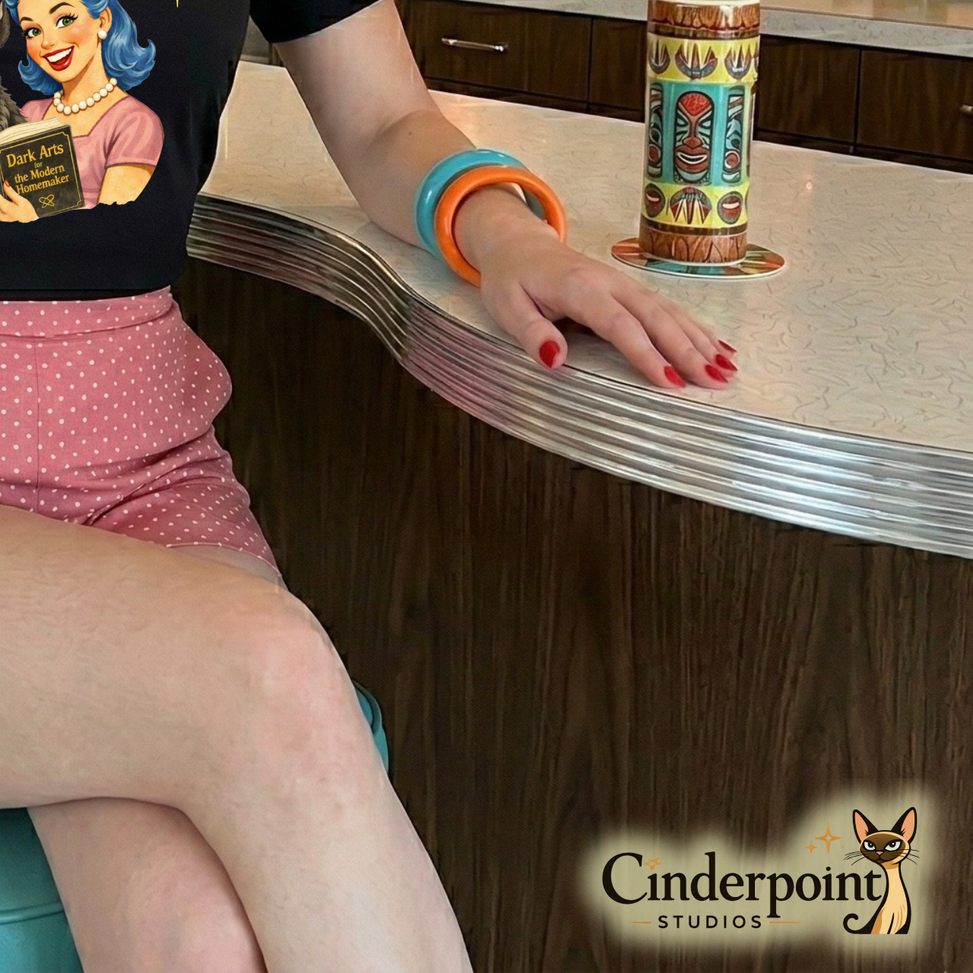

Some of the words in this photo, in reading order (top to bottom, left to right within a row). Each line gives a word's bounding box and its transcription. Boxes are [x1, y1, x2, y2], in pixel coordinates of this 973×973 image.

[6, 149, 36, 168] Dark
[39, 144, 64, 160] Arts
[14, 173, 29, 184] the
[30, 165, 65, 180] Modern
[15, 175, 70, 195] Homemaker
